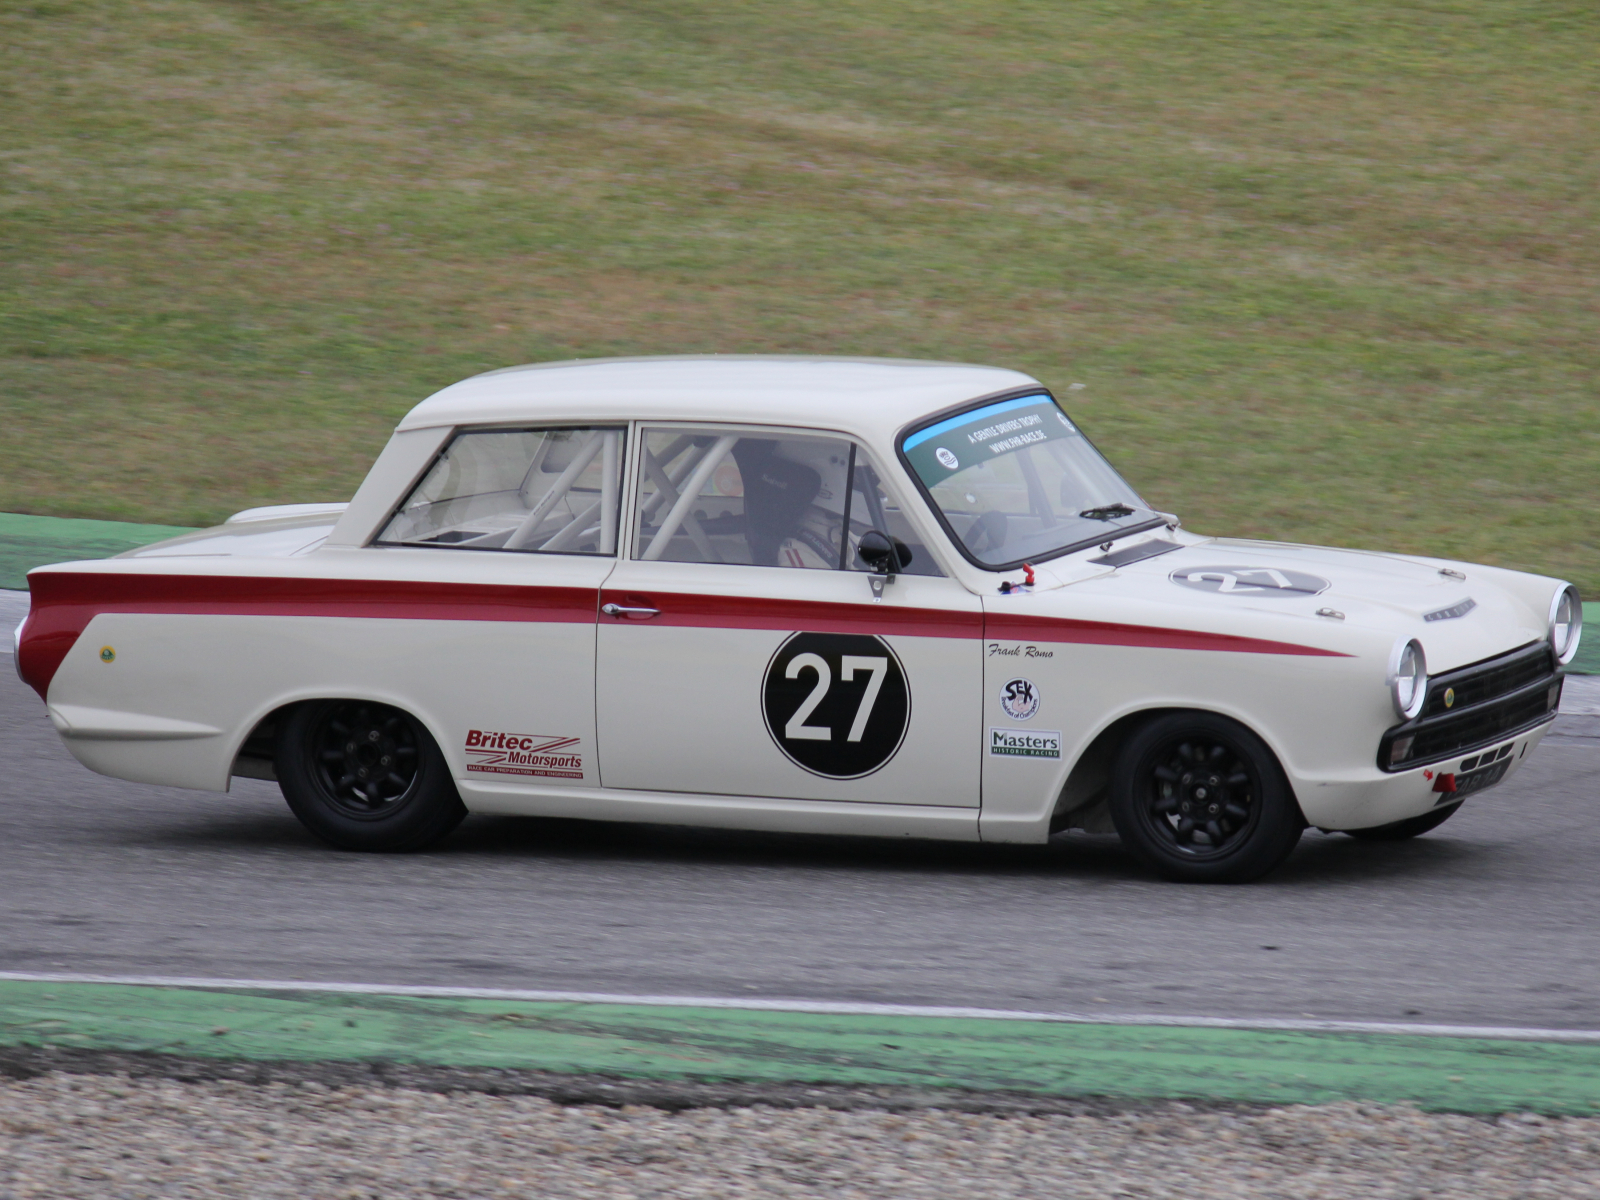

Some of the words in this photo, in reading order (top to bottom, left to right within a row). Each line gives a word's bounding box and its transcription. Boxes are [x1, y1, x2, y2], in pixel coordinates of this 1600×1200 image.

[967, 434, 976, 444] A
[973, 426, 998, 442] GENTLE
[994, 419, 1022, 434] DRIVERS
[1017, 414, 1043, 427] TROPHY
[1187, 568, 1293, 593] 27
[988, 643, 1021, 657] Frank
[1024, 645, 1053, 658] Romo
[785, 652, 888, 742] 27
[1005, 679, 1033, 705] SEX
[465, 729, 533, 751] Britec
[993, 731, 1058, 749] Masters
[508, 751, 582, 768] Motorsports
[1030, 749, 1058, 757] RACING
[496, 767, 533, 775] PREPARATION
